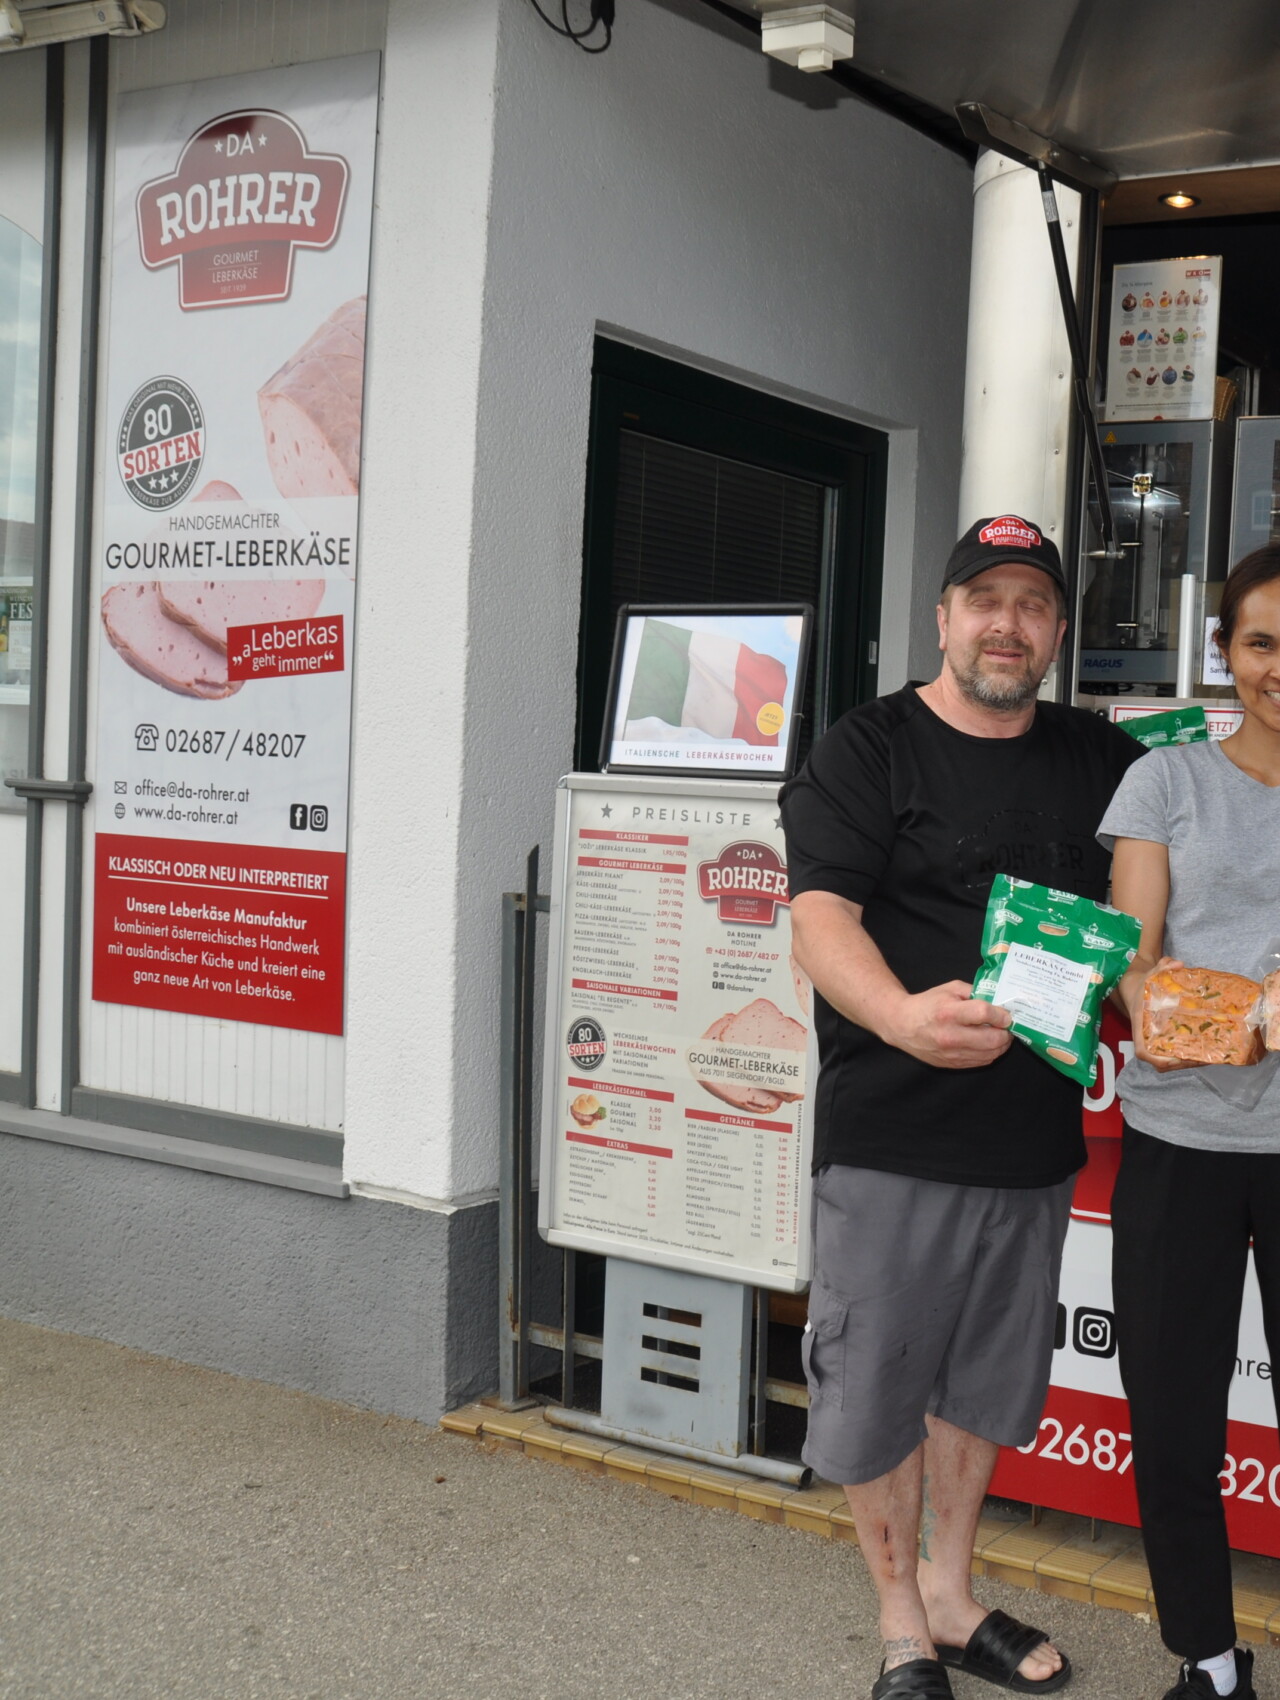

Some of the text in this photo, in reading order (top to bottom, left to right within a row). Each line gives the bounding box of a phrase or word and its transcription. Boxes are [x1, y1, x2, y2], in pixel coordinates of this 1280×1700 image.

[225, 131, 254, 157] DA
[156, 171, 321, 246] ROHRER
[213, 249, 259, 266] GOURMET
[211, 265, 258, 283] LEBERKÄSE
[144, 403, 172, 441] 80
[123, 431, 201, 480] SORTEN
[169, 513, 280, 532] HANDGEMACHTER
[985, 525, 1036, 541] ROHRER
[106, 531, 351, 570] GOURMET-LEBERKÄSE
[252, 621, 338, 654] Leberkas
[252, 654, 276, 672] geht
[1084, 659, 1123, 668] RAGUS
[625, 749, 773, 762] ITALIENSCHE LEBERKÄSEWOCHEN
[134, 780, 250, 804] office@da-rohrer.at
[134, 804, 238, 826] www.da-rohrer.at
[632, 806, 751, 826] PREISLISTE
[616, 832, 649, 841] KLASSIKER
[742, 849, 757, 860] DA
[108, 855, 329, 892] KLASSISCH ODER NEU INTERPRETIERT
[599, 860, 664, 871] GOURMET LEBERKÄSE
[707, 866, 788, 897] ROHRER
[126, 897, 307, 930] Unsere Leberkäse Manufaktur
[114, 918, 320, 956] kombiniert österreichisches Handwerk
[107, 941, 326, 981] mit ausländischer Küche und kreiert eine
[133, 969, 296, 1002] ganz neue Art von Leberkäse.
[586, 981, 662, 997] SAISONALE VARIATIONEN
[578, 1027, 592, 1042] 80
[569, 1042, 605, 1056] SORTEN
[613, 1040, 676, 1054] LEBERKÄSEWOCHEN
[716, 1046, 771, 1060] HANDGEMACHTER
[689, 1052, 799, 1077] GOURMET-LEBERKÄSE
[592, 1083, 647, 1098] LEBERKÄSESEMMEL
[720, 1116, 755, 1127] GETRÄNKE
[606, 1140, 629, 1150] EXTRAS
